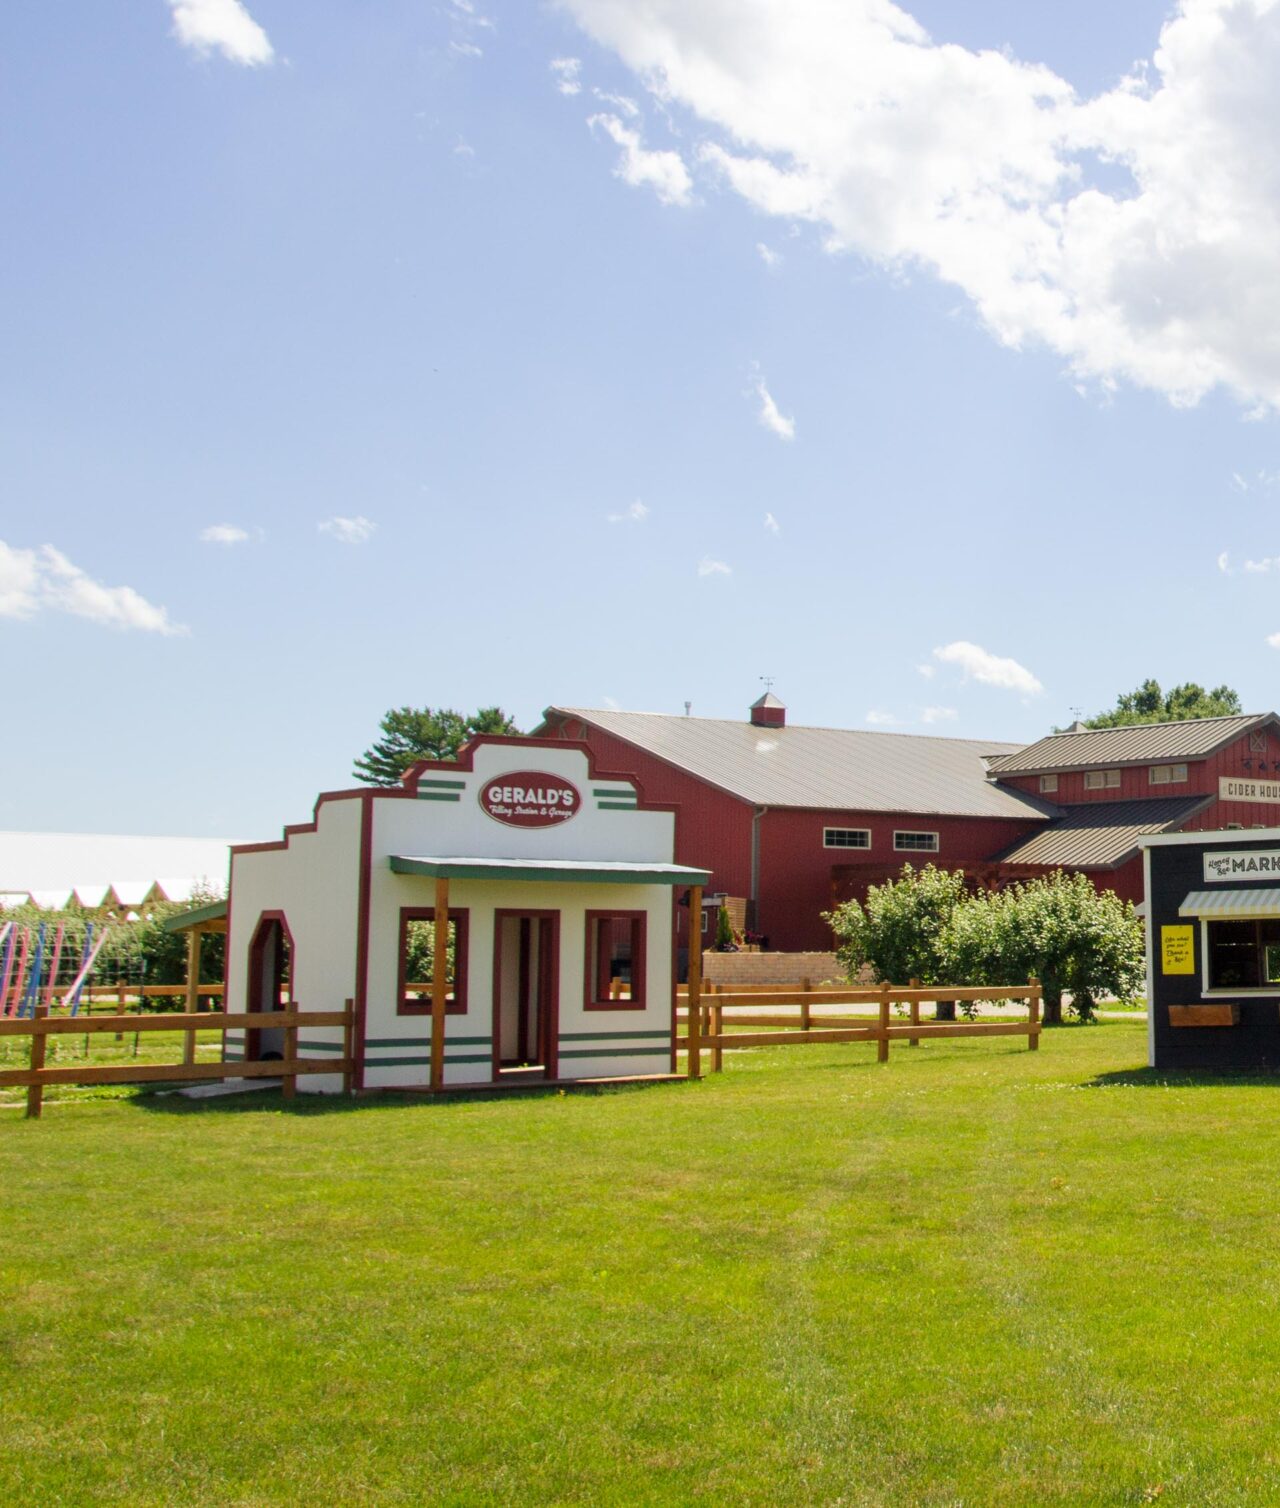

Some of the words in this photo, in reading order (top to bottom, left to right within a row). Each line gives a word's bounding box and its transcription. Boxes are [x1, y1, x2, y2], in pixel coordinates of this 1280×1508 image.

[488, 786, 574, 806] GERALD'S
[1228, 783, 1256, 797] CIDER
[540, 807, 547, 816] &
